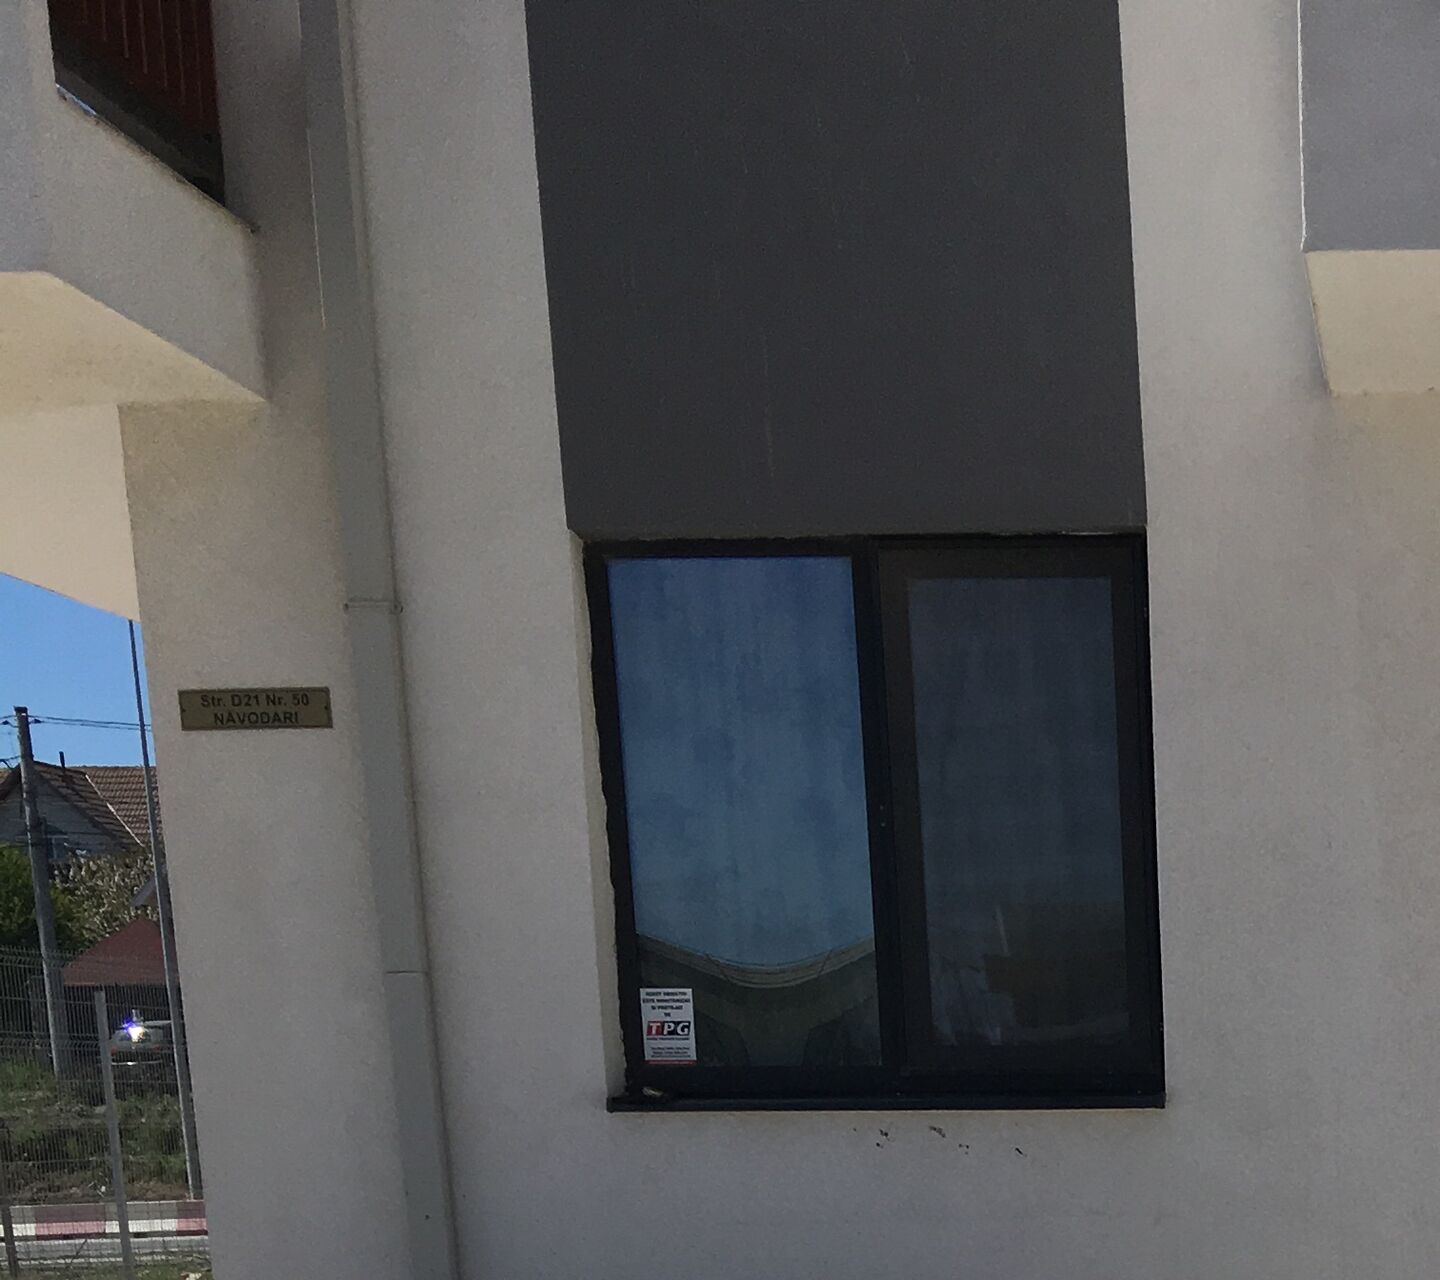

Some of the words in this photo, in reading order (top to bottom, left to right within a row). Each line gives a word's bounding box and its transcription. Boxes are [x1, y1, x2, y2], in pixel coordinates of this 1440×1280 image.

[200, 694, 226, 708] Str.
[231, 694, 260, 707] D21
[265, 693, 287, 706] Nr.
[291, 693, 310, 706] 50
[647, 1022, 690, 1035] TPG
